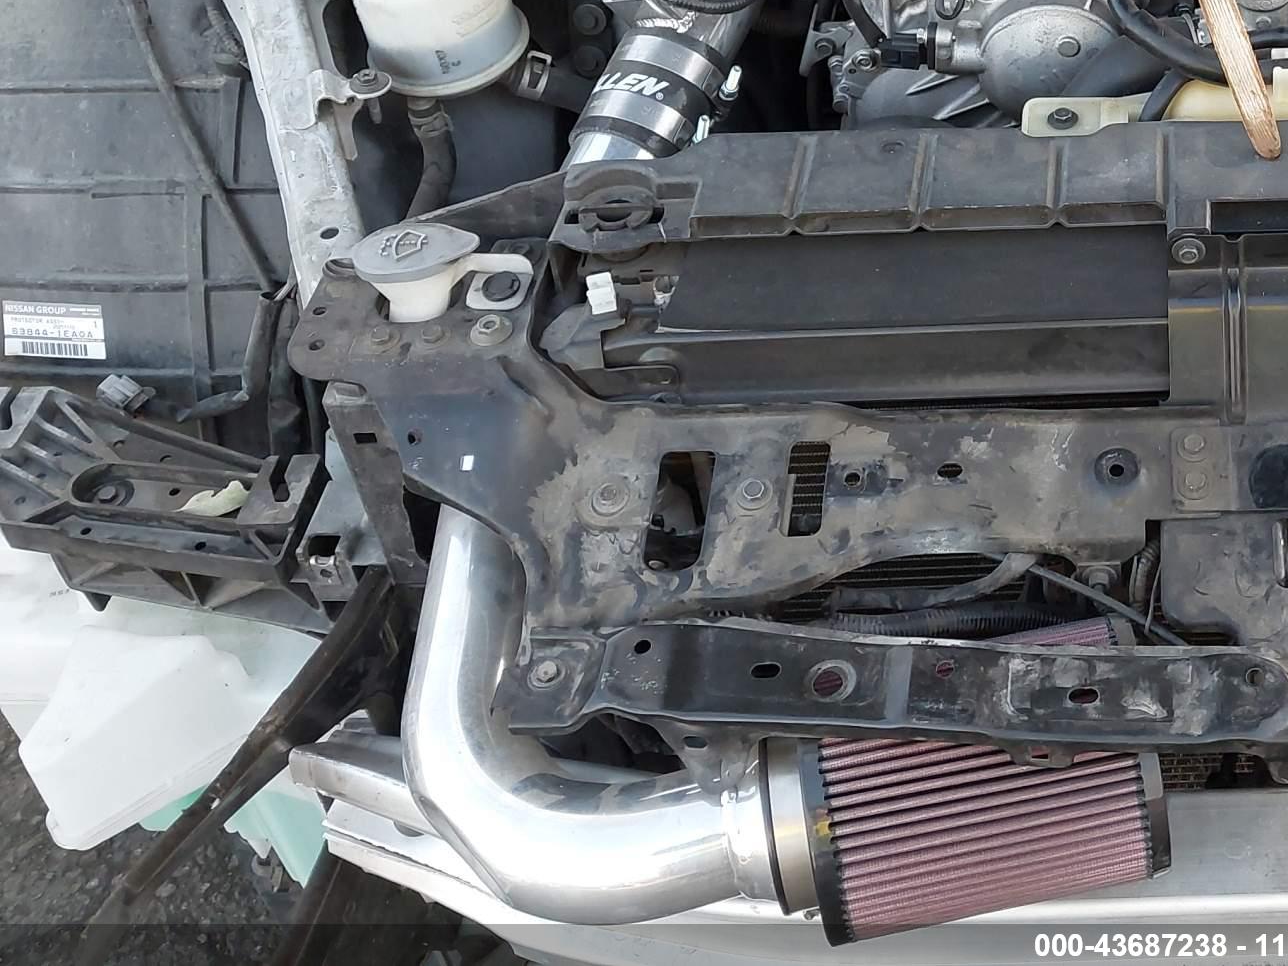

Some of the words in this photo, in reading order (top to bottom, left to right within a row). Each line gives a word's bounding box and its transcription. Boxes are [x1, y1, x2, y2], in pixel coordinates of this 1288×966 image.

[592, 72, 670, 96] LLEN
[5, 304, 35, 313] NISSAN
[35, 305, 67, 315] GROUP
